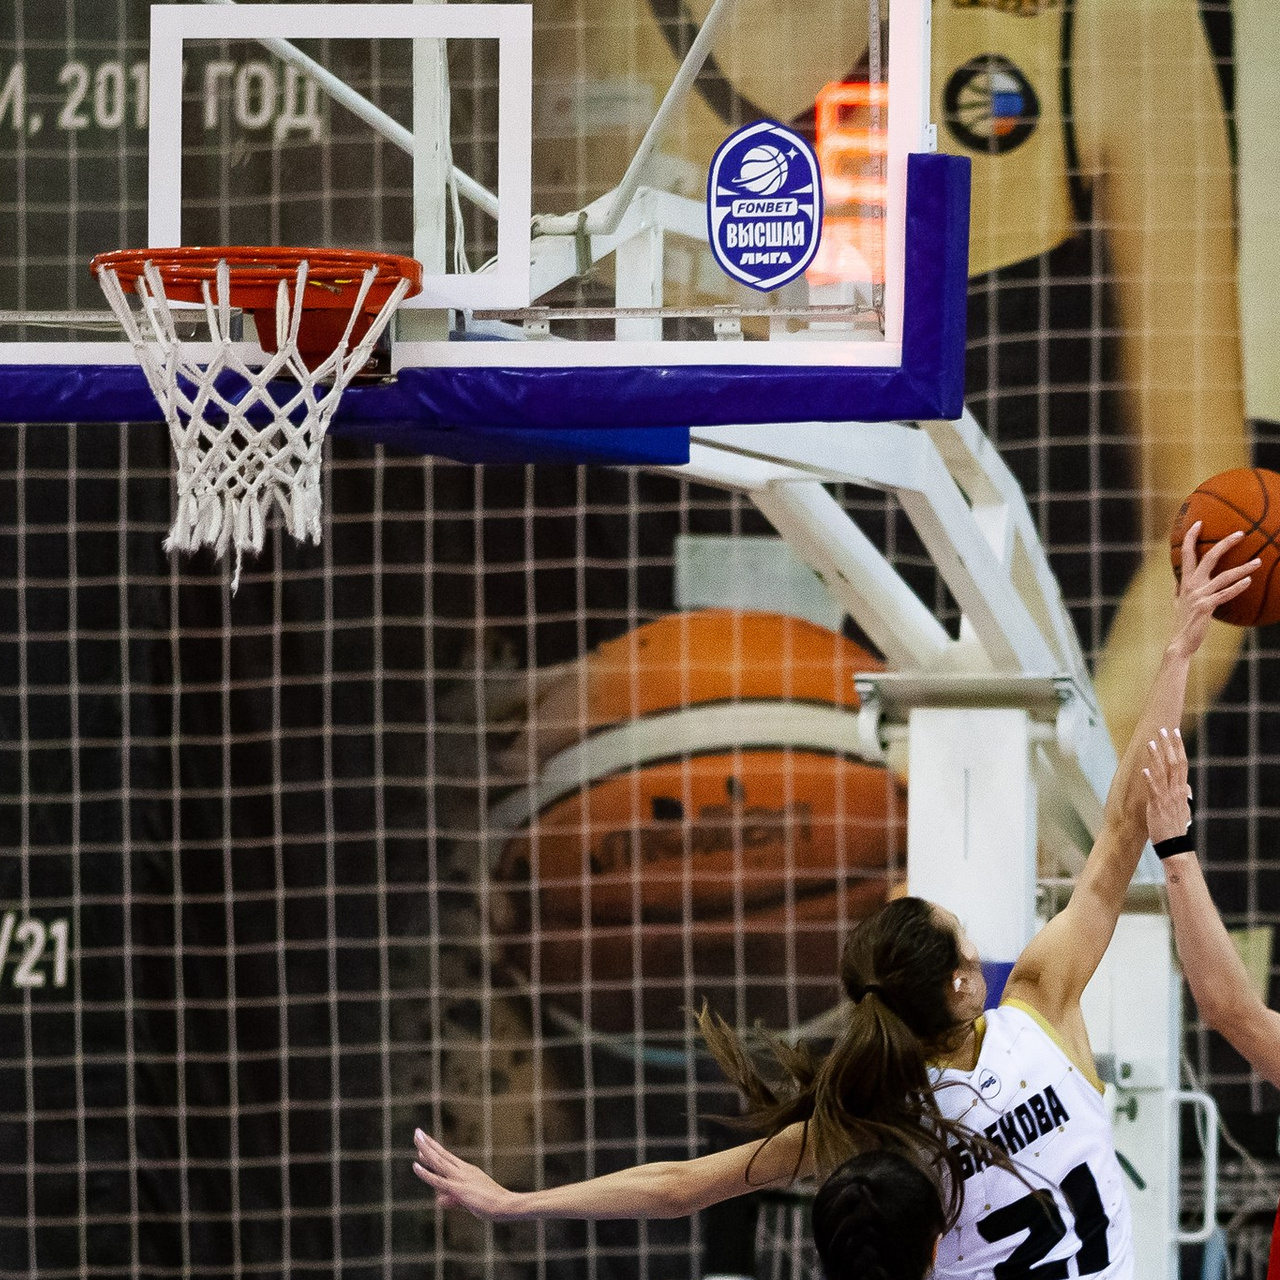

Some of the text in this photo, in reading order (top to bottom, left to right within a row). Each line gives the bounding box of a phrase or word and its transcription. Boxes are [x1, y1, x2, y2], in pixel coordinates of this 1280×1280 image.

[58, 61, 188, 130] 201
[202, 60, 322, 144] ГОД
[736, 201, 793, 214] FONBET
[726, 221, 805, 248] ВЫСШАЯ
[739, 252, 792, 265] ЛИГА
